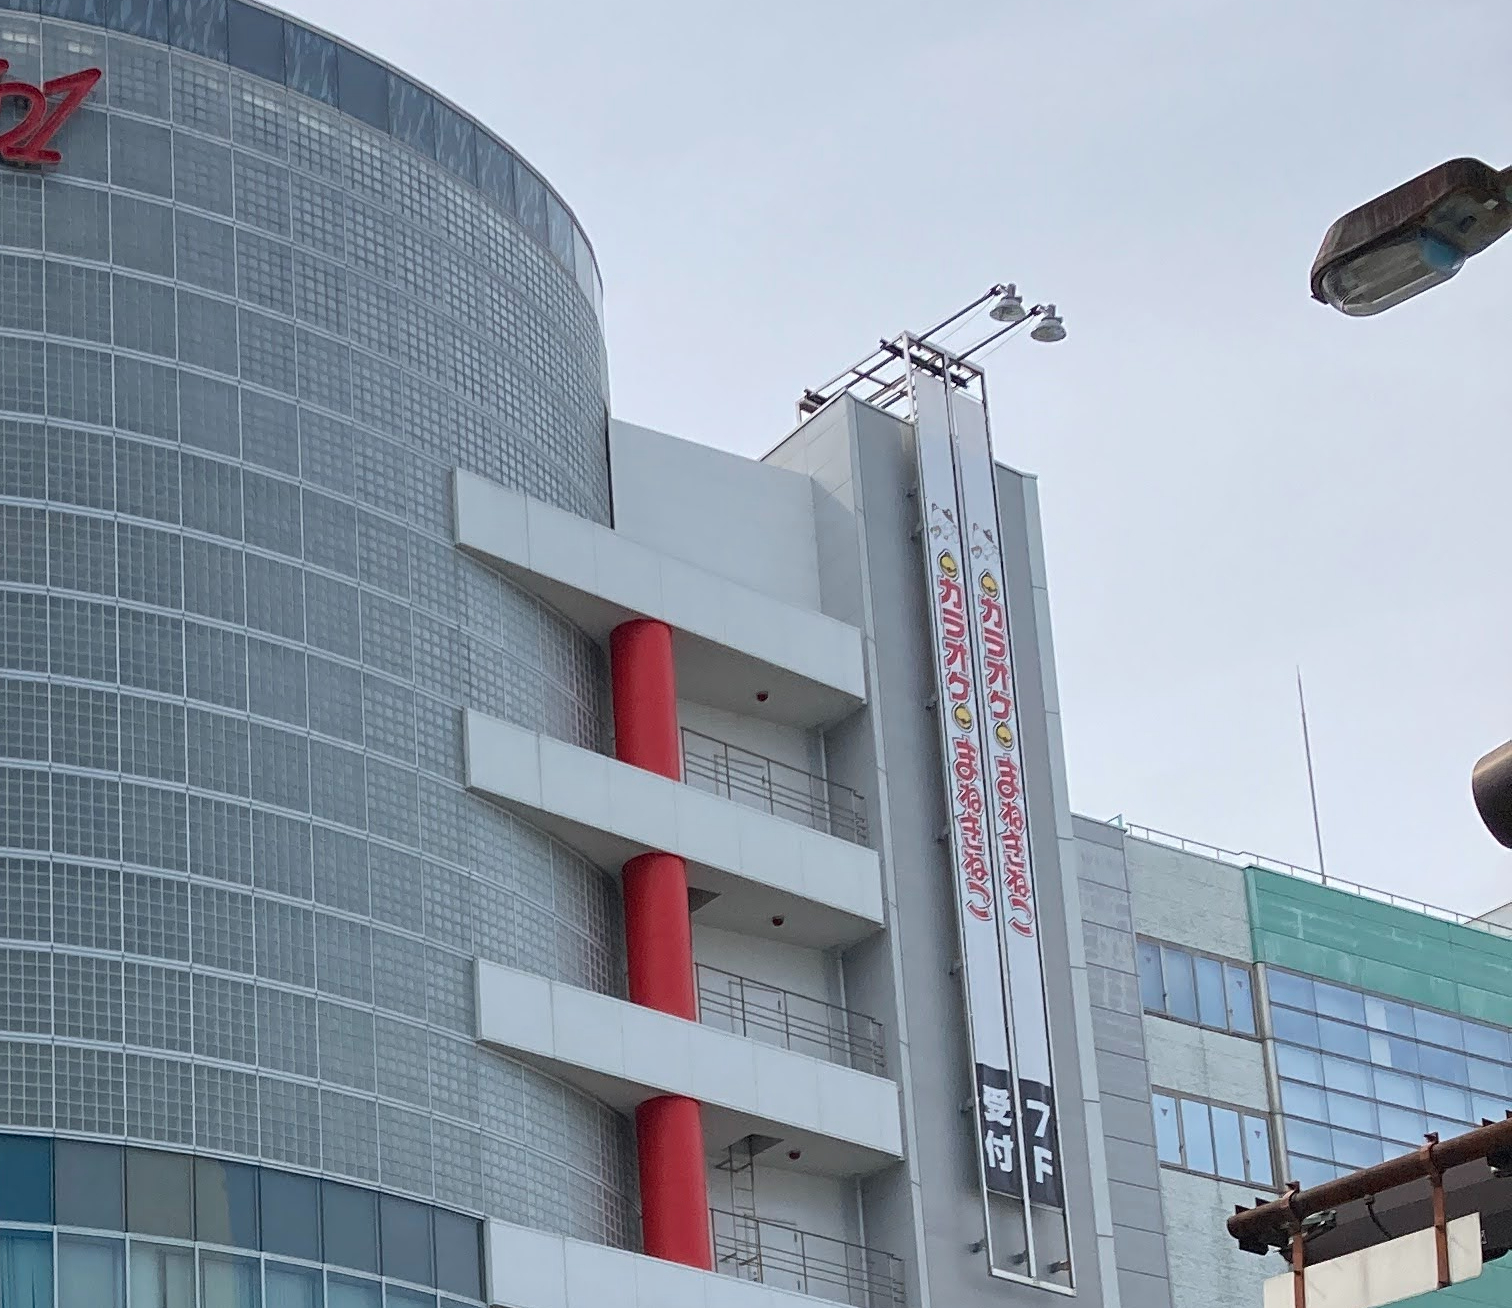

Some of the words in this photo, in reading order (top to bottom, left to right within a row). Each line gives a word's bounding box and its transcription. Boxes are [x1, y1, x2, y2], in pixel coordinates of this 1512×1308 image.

[938, 577, 972, 704] カラオケ
[979, 596, 1013, 724] カラオケ
[951, 733, 994, 922] まねきねこ
[994, 752, 1036, 938] まねきねこ
[982, 1084, 1014, 1172] 受付
[1026, 1098, 1053, 1184] 7F
